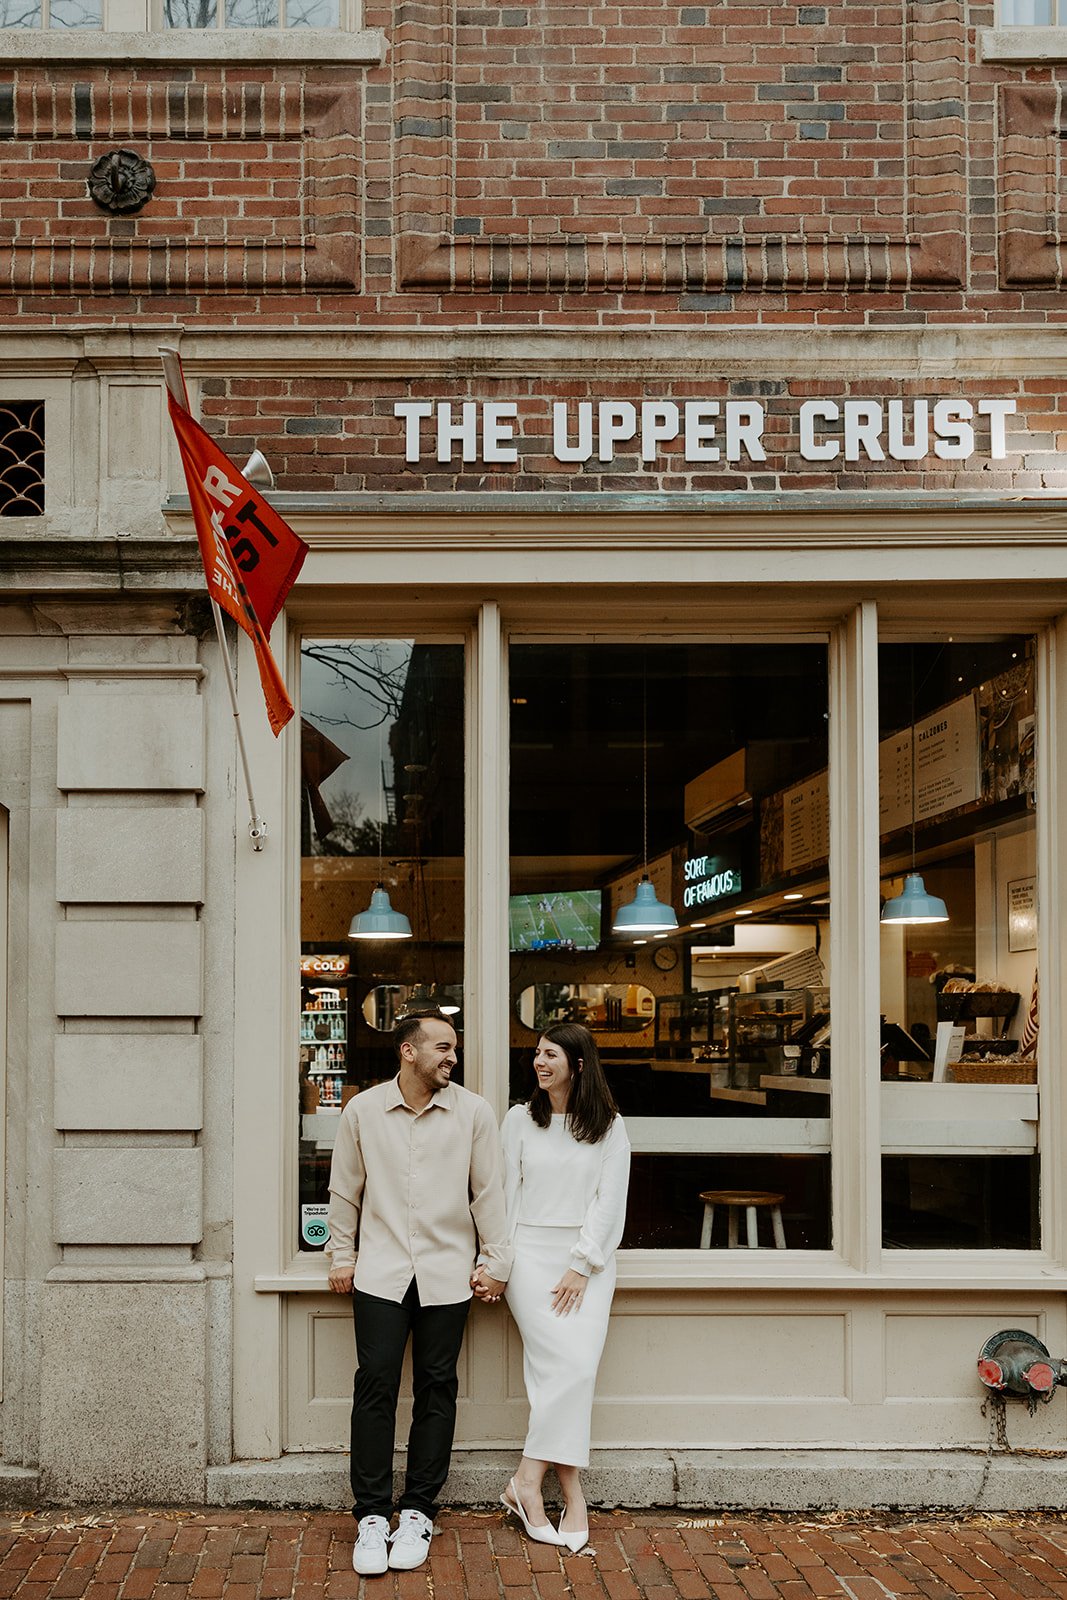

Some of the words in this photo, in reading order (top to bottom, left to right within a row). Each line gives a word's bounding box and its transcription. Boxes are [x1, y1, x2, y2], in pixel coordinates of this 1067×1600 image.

[394, 402, 518, 463] THE
[553, 401, 767, 463] UPPER
[799, 399, 1016, 461] CRUST
[918, 720, 948, 742] CALZONES
[684, 855, 709, 880] SORT
[684, 886, 696, 907] OF
[696, 869, 733, 903] FAMOUS
[313, 960, 345, 971] COLD
